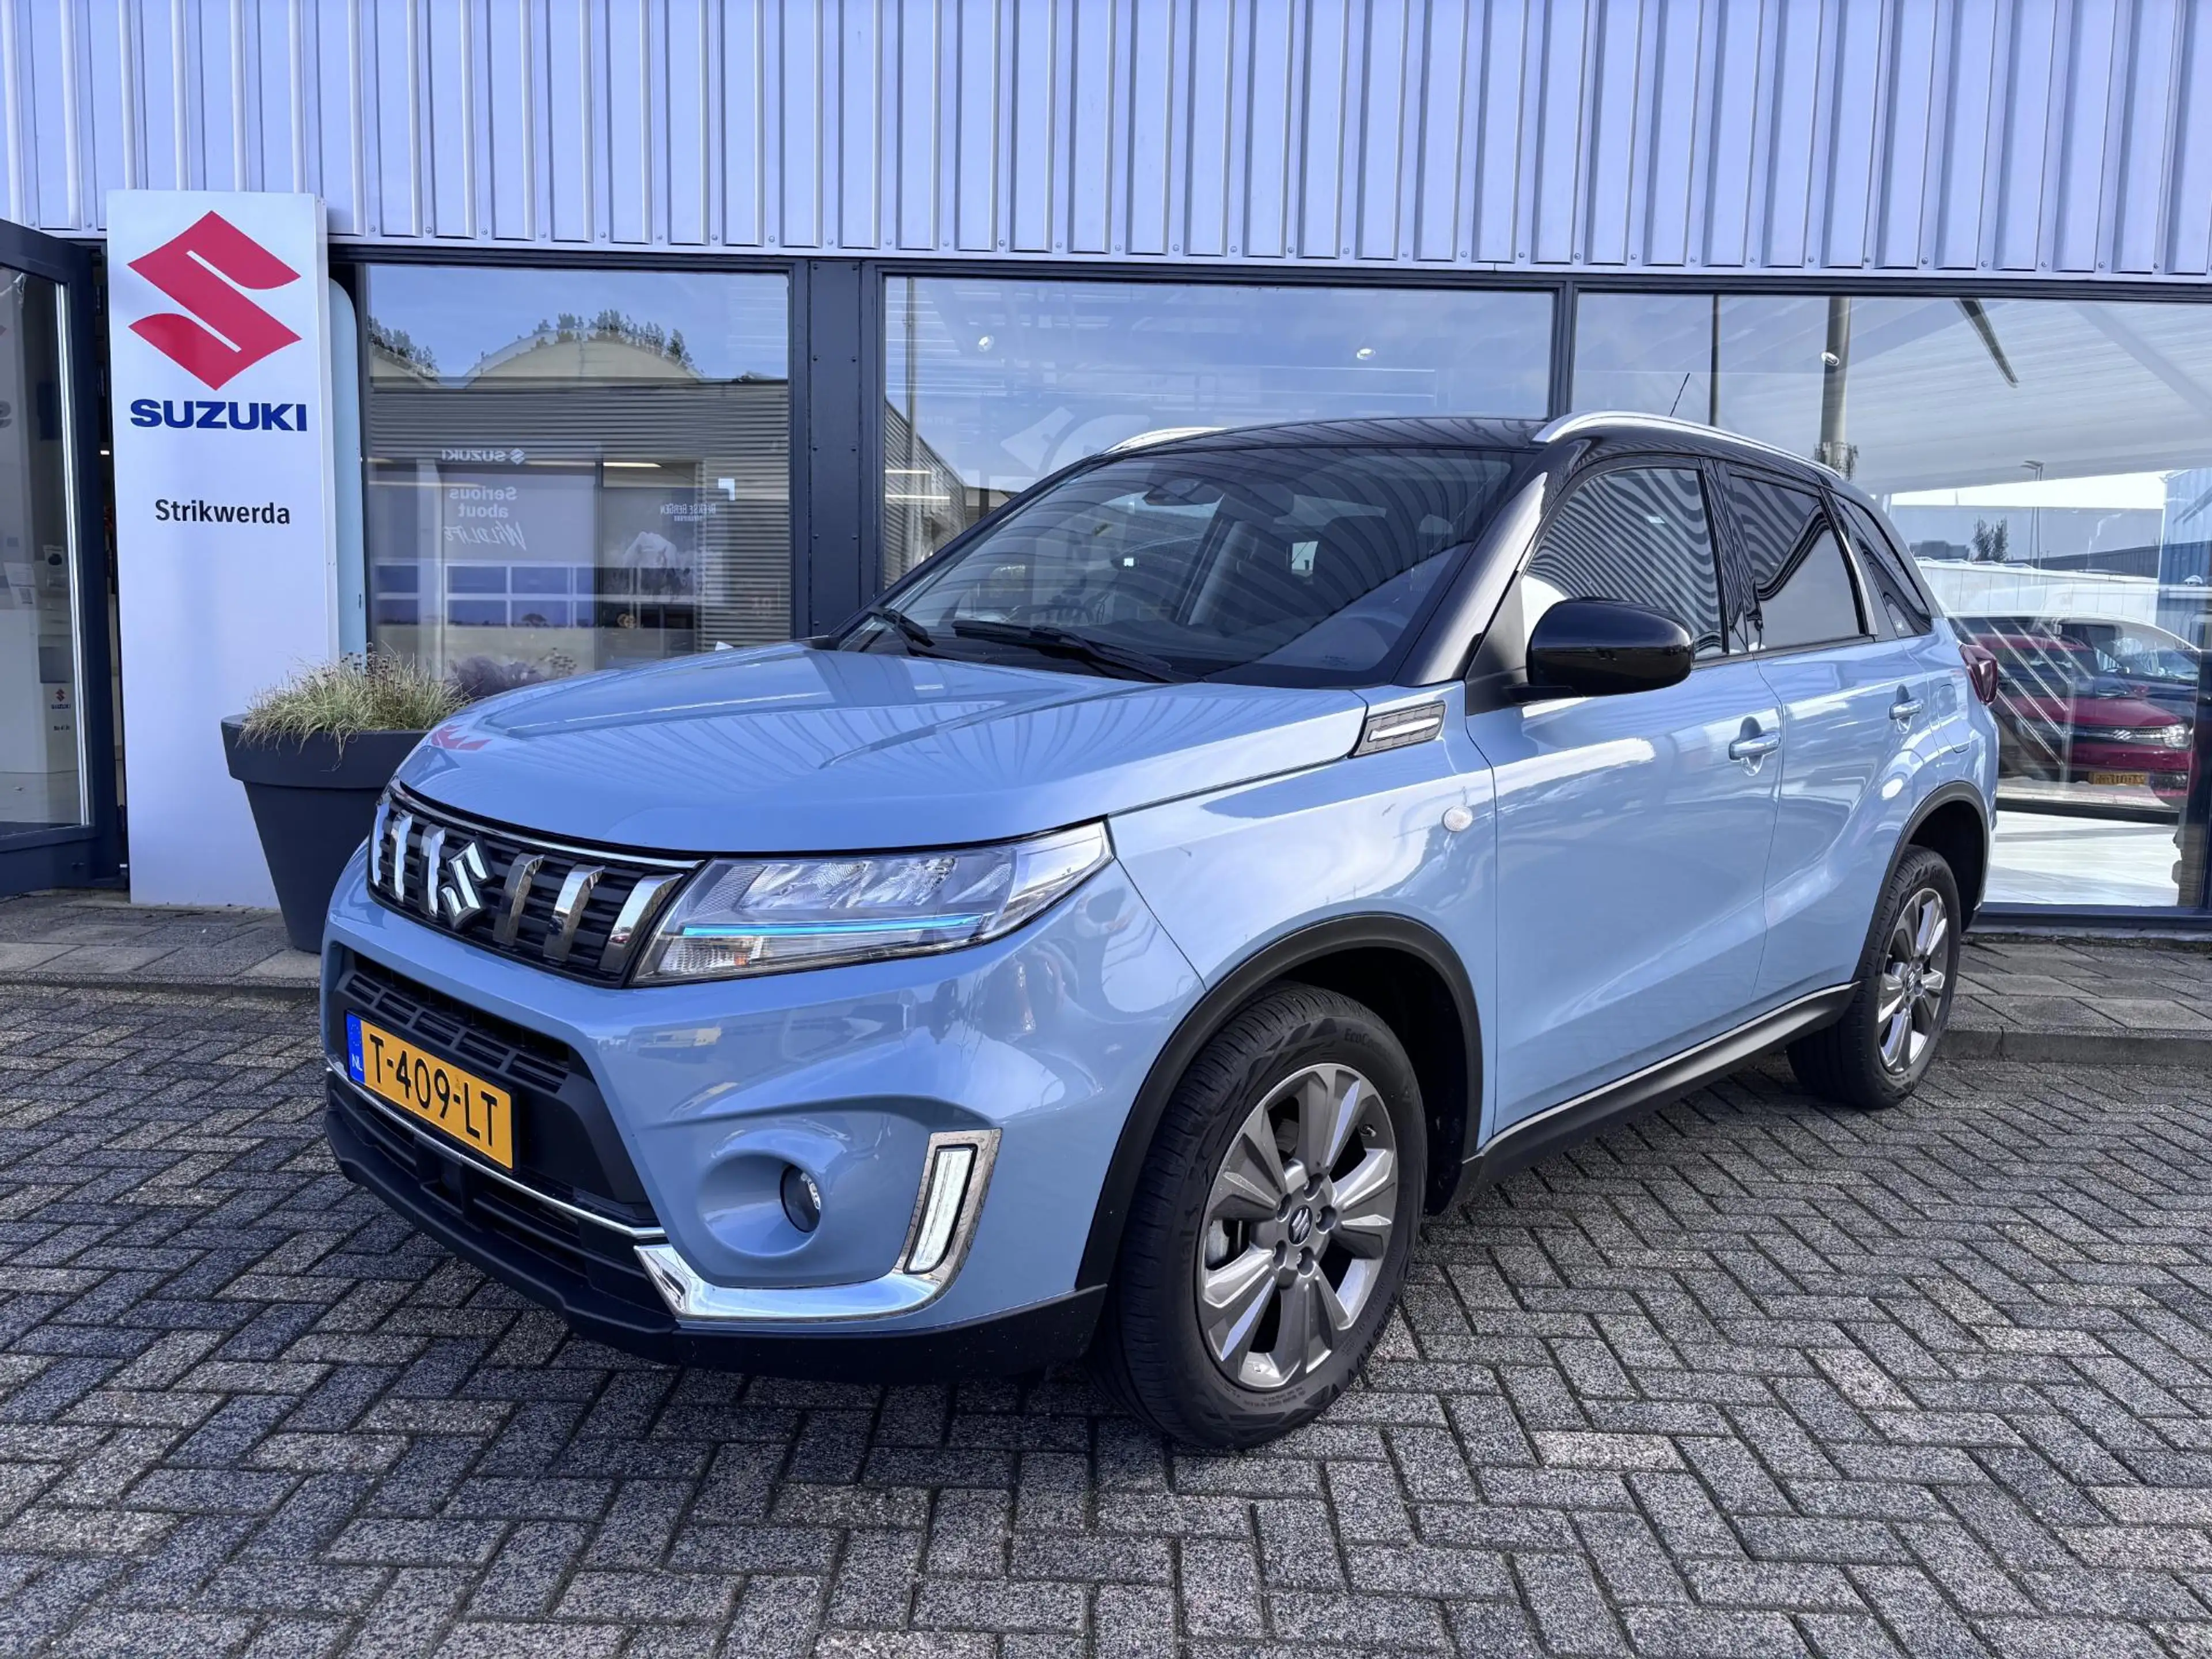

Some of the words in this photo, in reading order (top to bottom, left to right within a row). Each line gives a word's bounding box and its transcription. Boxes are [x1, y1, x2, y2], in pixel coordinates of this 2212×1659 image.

[130, 399, 307, 431] SUZUKI
[155, 499, 290, 524] Strikwerda
[352, 1053, 363, 1071] NL
[369, 1033, 498, 1147] T-409-LT
